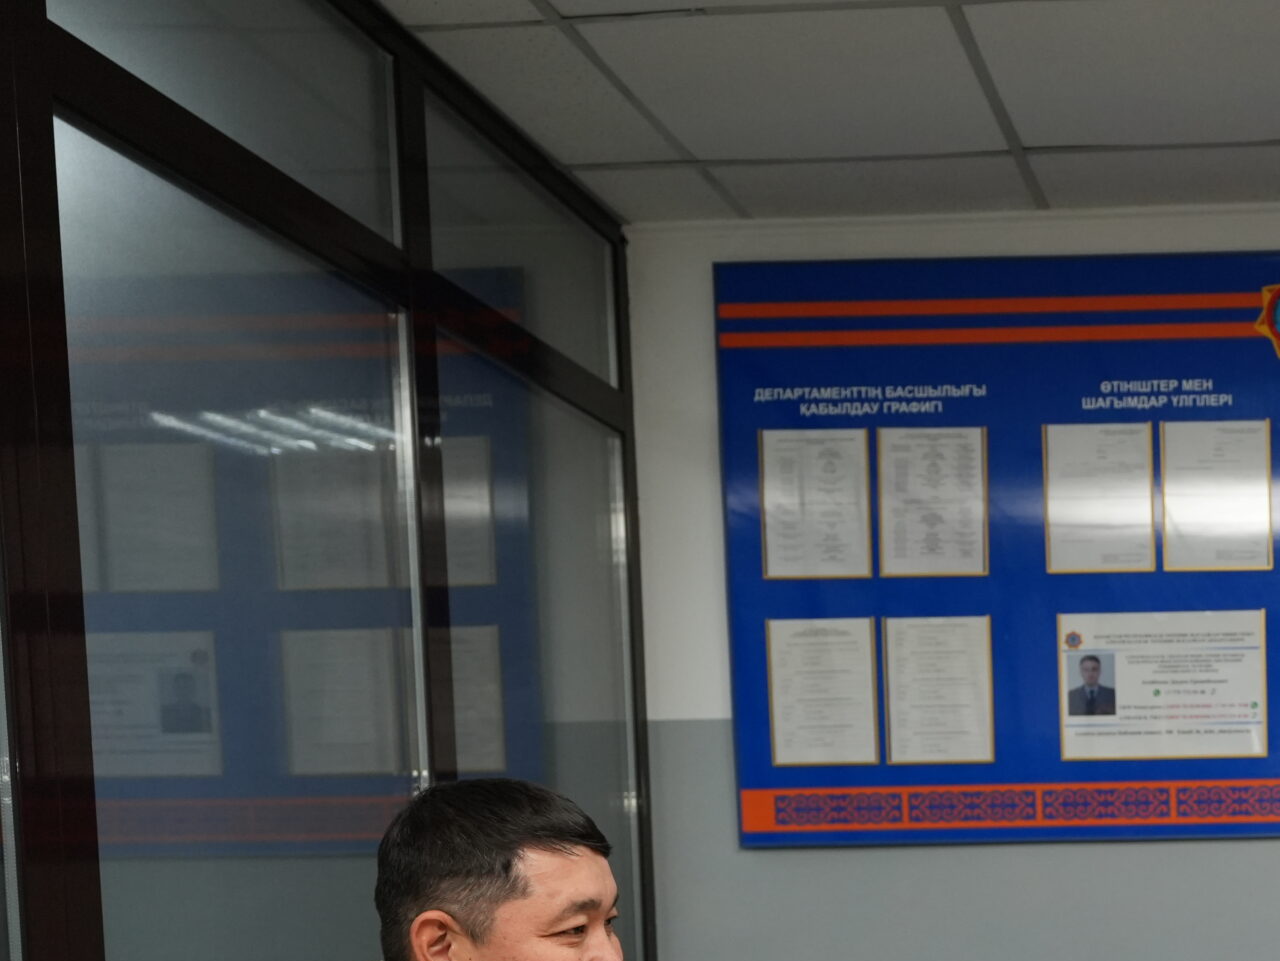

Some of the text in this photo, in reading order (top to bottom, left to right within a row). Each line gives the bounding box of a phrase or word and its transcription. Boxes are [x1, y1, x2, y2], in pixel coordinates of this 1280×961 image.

[754, 386, 882, 401] ДЕПАРТАМЕНТТІҢ
[1100, 379, 1213, 393] ӨТІНІШТЕР МЕН
[800, 401, 943, 416] ҚАБЫЛДАУ ГРАФИГІ
[1081, 395, 1168, 410] ШАҒЫМДАР
